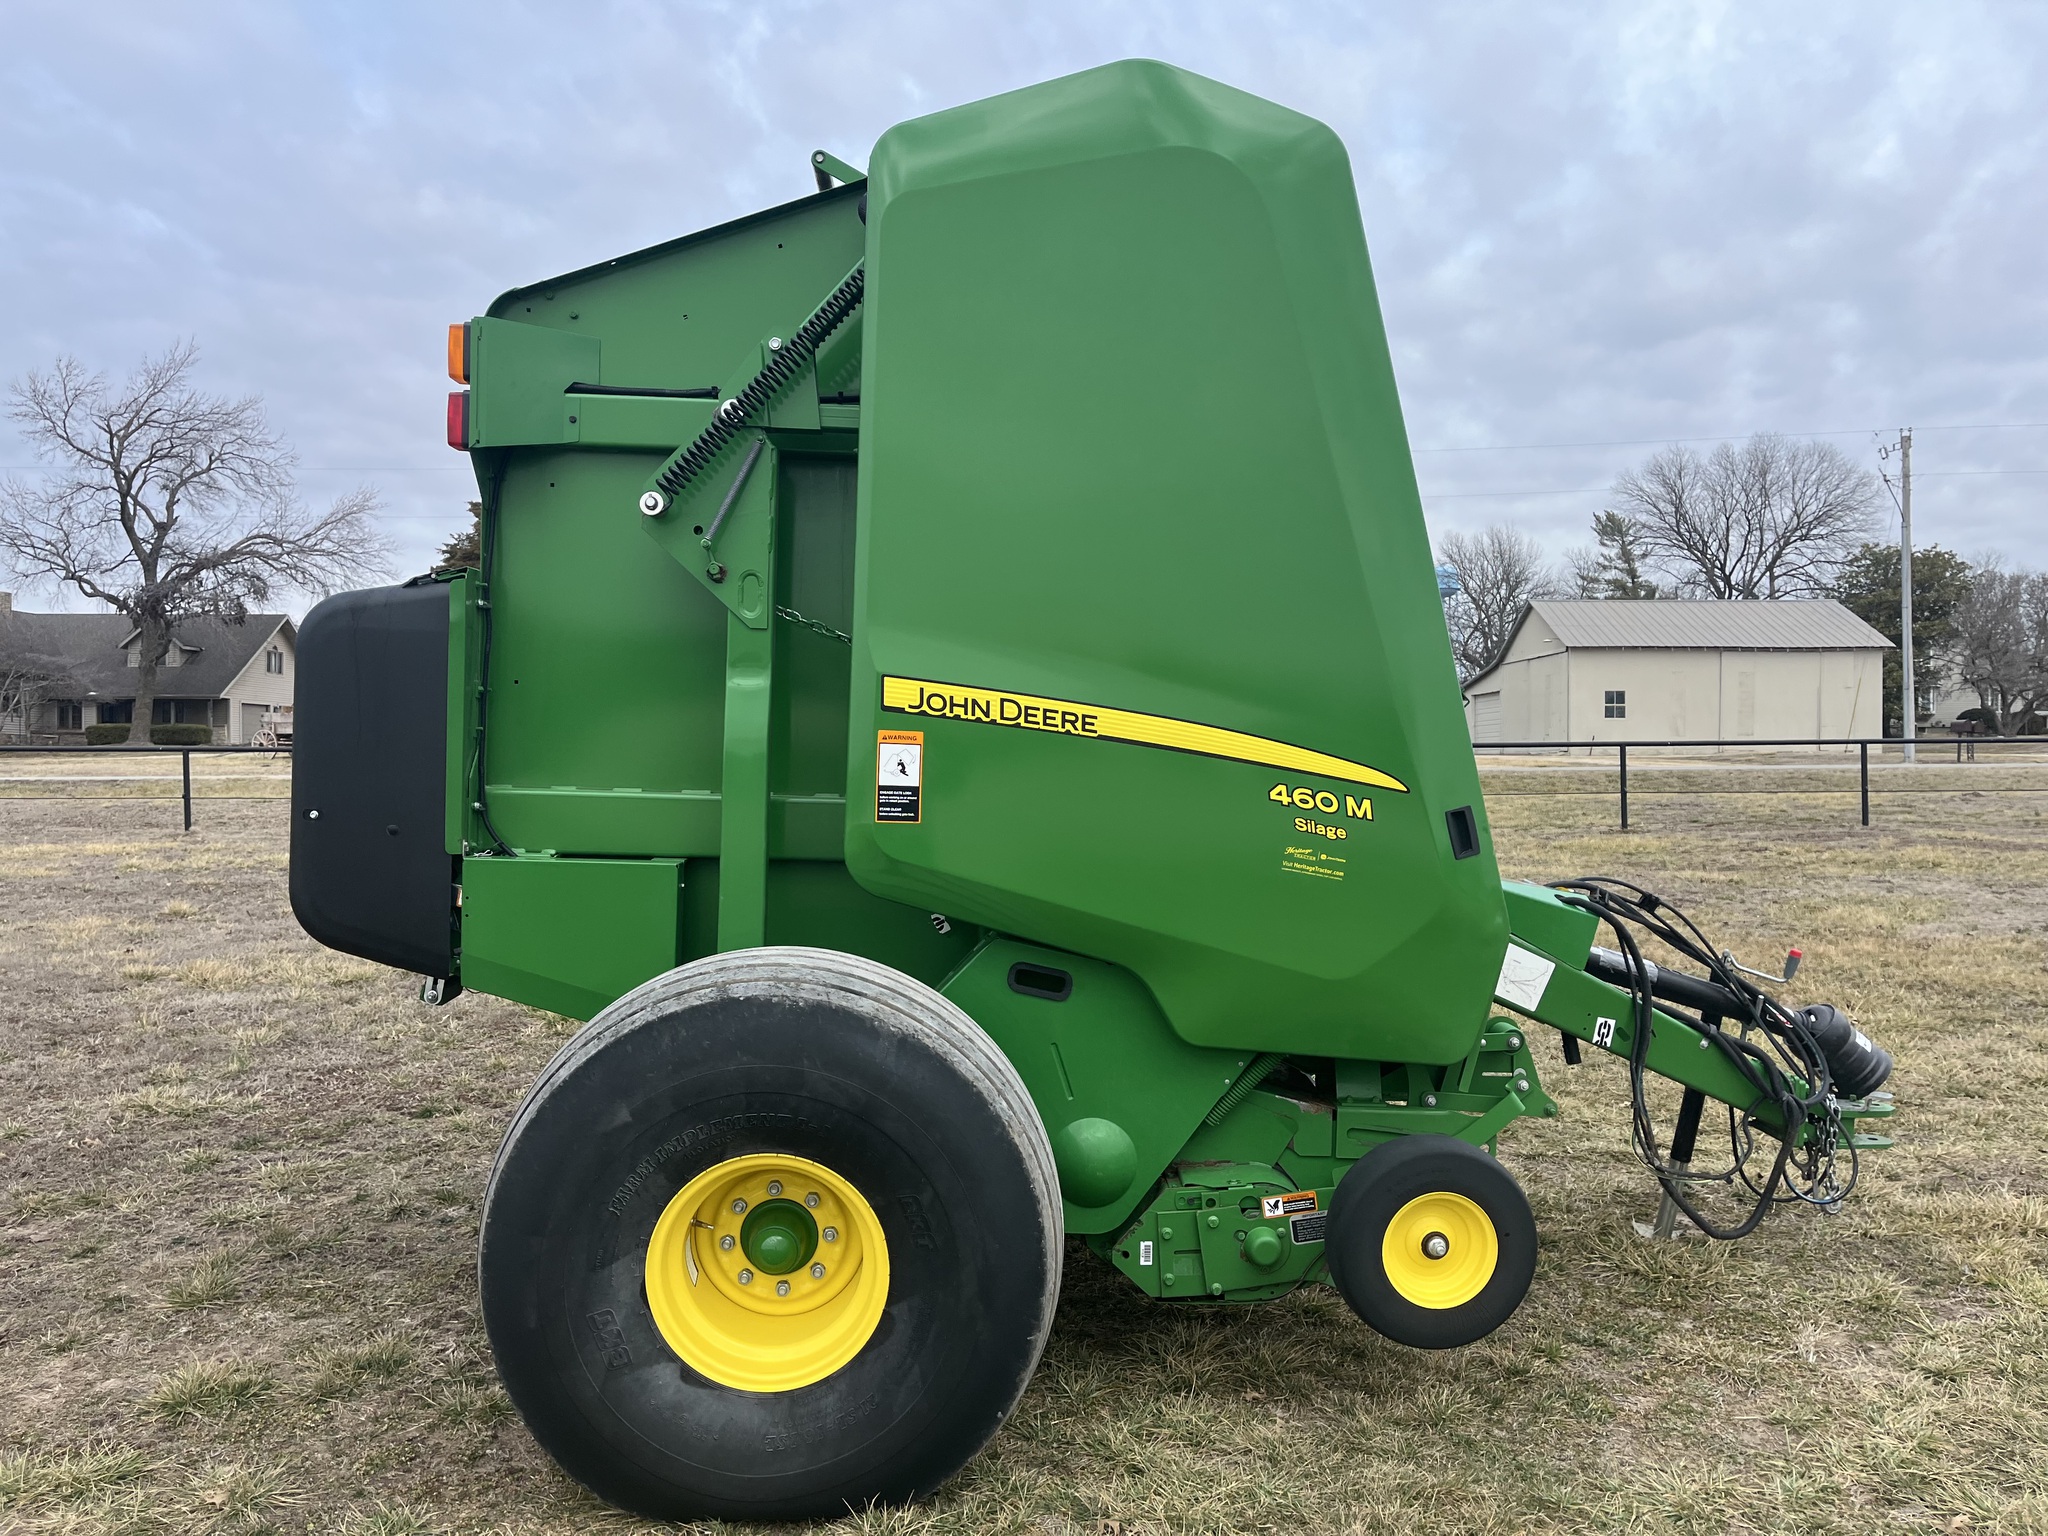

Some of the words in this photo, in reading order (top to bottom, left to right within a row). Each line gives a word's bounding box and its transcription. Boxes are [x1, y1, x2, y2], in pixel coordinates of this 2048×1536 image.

[908, 687, 991, 720] JOHN
[999, 698, 1098, 735] DEERE
[1269, 783, 1339, 814] 460
[1345, 794, 1373, 821] M
[1294, 817, 1347, 840] Silage
[1284, 846, 1313, 855] Heritage
[1293, 862, 1344, 876] HeritageTractor.com
[608, 1157, 657, 1216] FARM
[656, 1112, 793, 1164] IMPLEMENT
[590, 1311, 630, 1369] BKT
